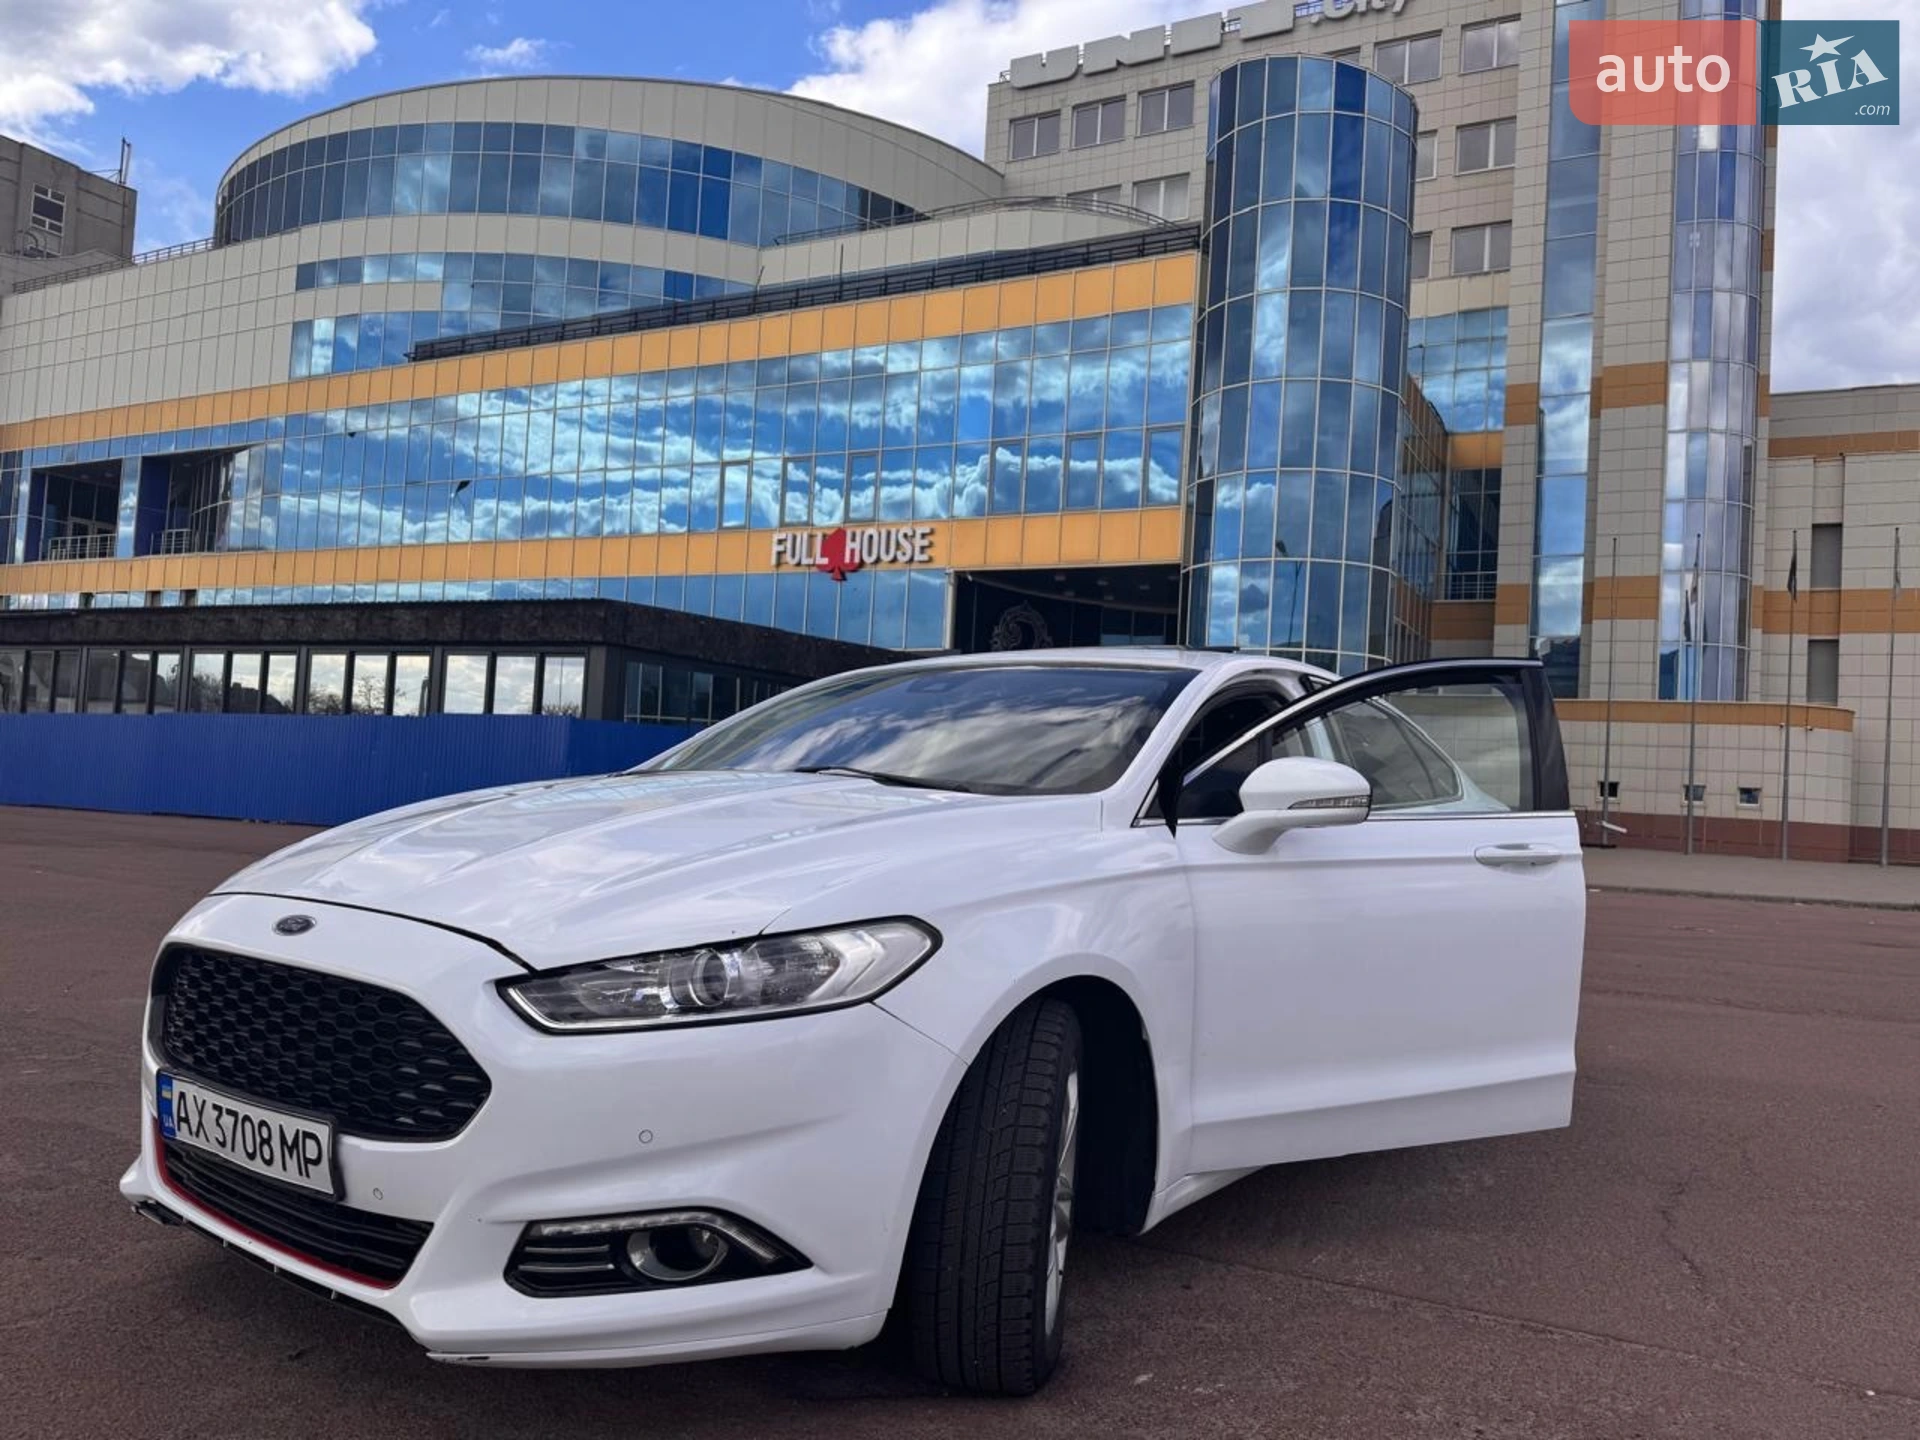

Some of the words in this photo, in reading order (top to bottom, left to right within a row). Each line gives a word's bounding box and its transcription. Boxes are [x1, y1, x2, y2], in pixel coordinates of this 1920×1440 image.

[771, 532, 829, 566] FULL
[844, 527, 932, 564] HOUSE
[176, 1091, 210, 1143] AX
[212, 1103, 274, 1166] 3708
[279, 1123, 322, 1179] MP
